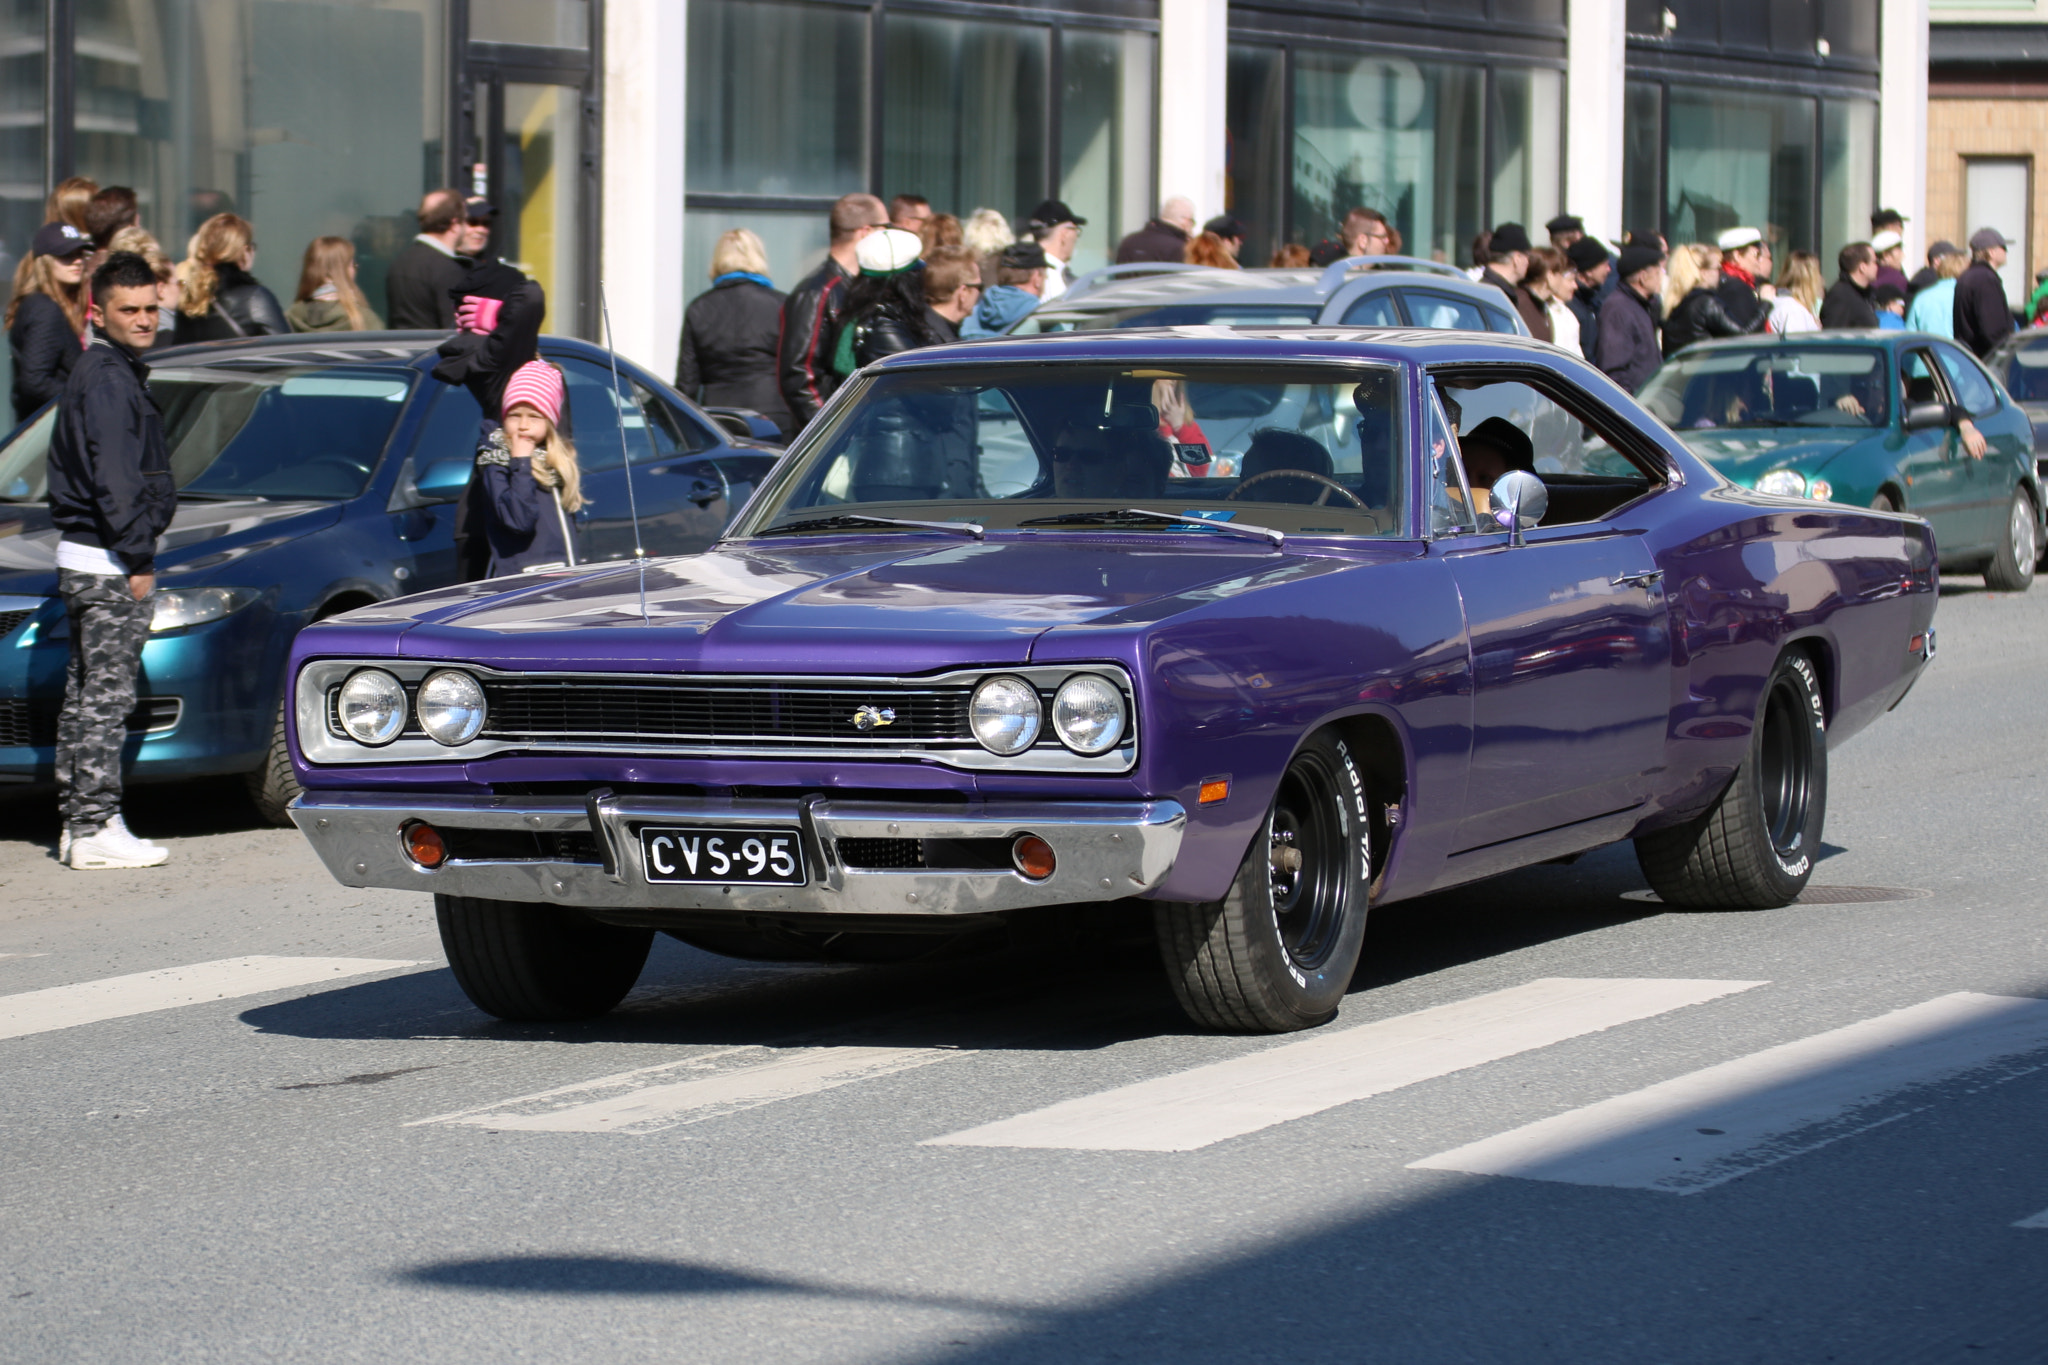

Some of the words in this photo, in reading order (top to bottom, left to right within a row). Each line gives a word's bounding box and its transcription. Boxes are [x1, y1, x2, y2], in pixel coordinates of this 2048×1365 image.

[1785, 656, 1813, 692] RADIAL
[1336, 740, 1367, 823] Radial
[1361, 832, 1369, 880] T/A
[651, 836, 795, 877] CVS-95
